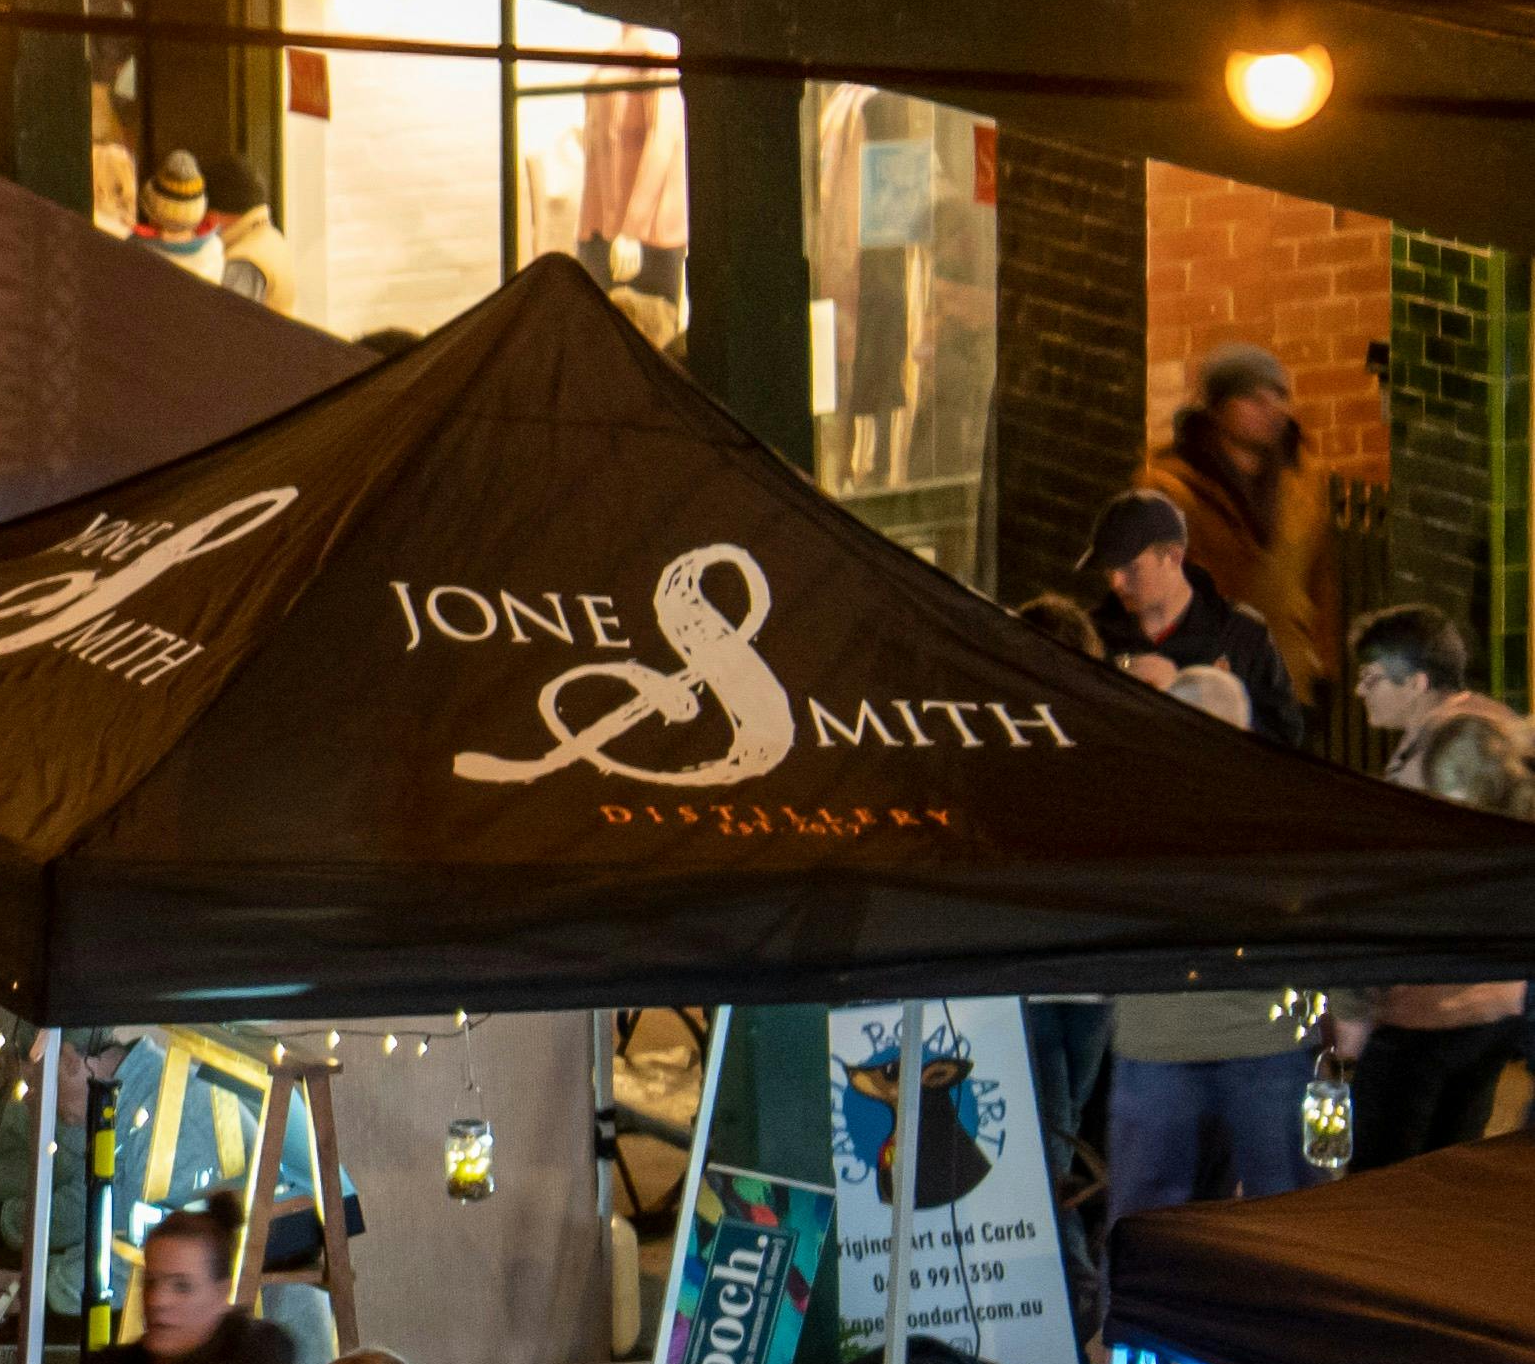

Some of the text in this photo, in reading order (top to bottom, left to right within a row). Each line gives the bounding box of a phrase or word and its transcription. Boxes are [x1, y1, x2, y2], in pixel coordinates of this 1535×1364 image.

[599, 804, 952, 830] DISTILLERY
[981, 1219, 1036, 1244] Cards
[927, 1266, 961, 1288] 991
[969, 1259, 1005, 1284] 350
